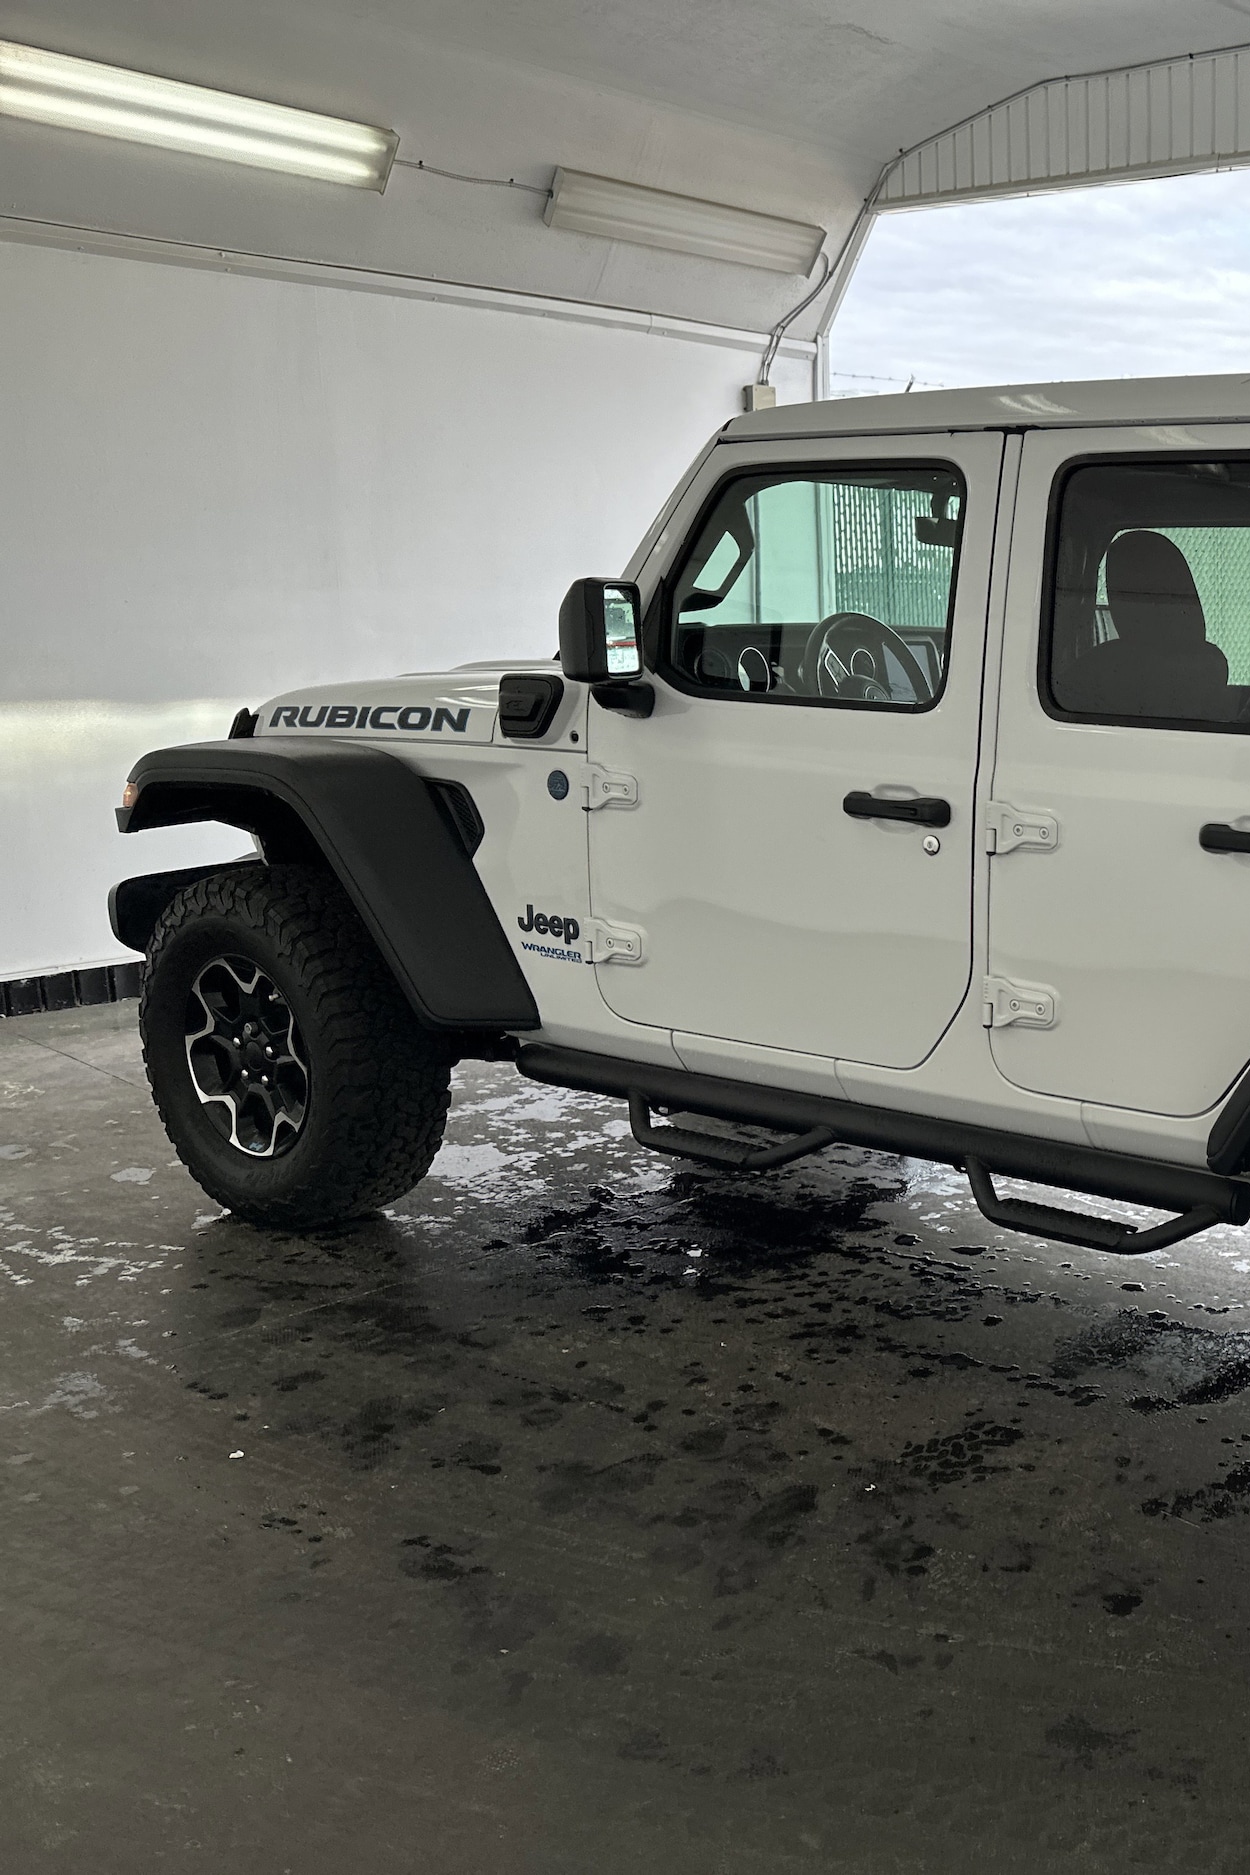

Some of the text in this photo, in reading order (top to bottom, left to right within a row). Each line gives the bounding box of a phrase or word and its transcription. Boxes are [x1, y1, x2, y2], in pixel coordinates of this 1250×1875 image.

[268, 705, 471, 732] RUBICON
[517, 904, 580, 944] Jeep
[521, 941, 581, 959] WRANGLER
